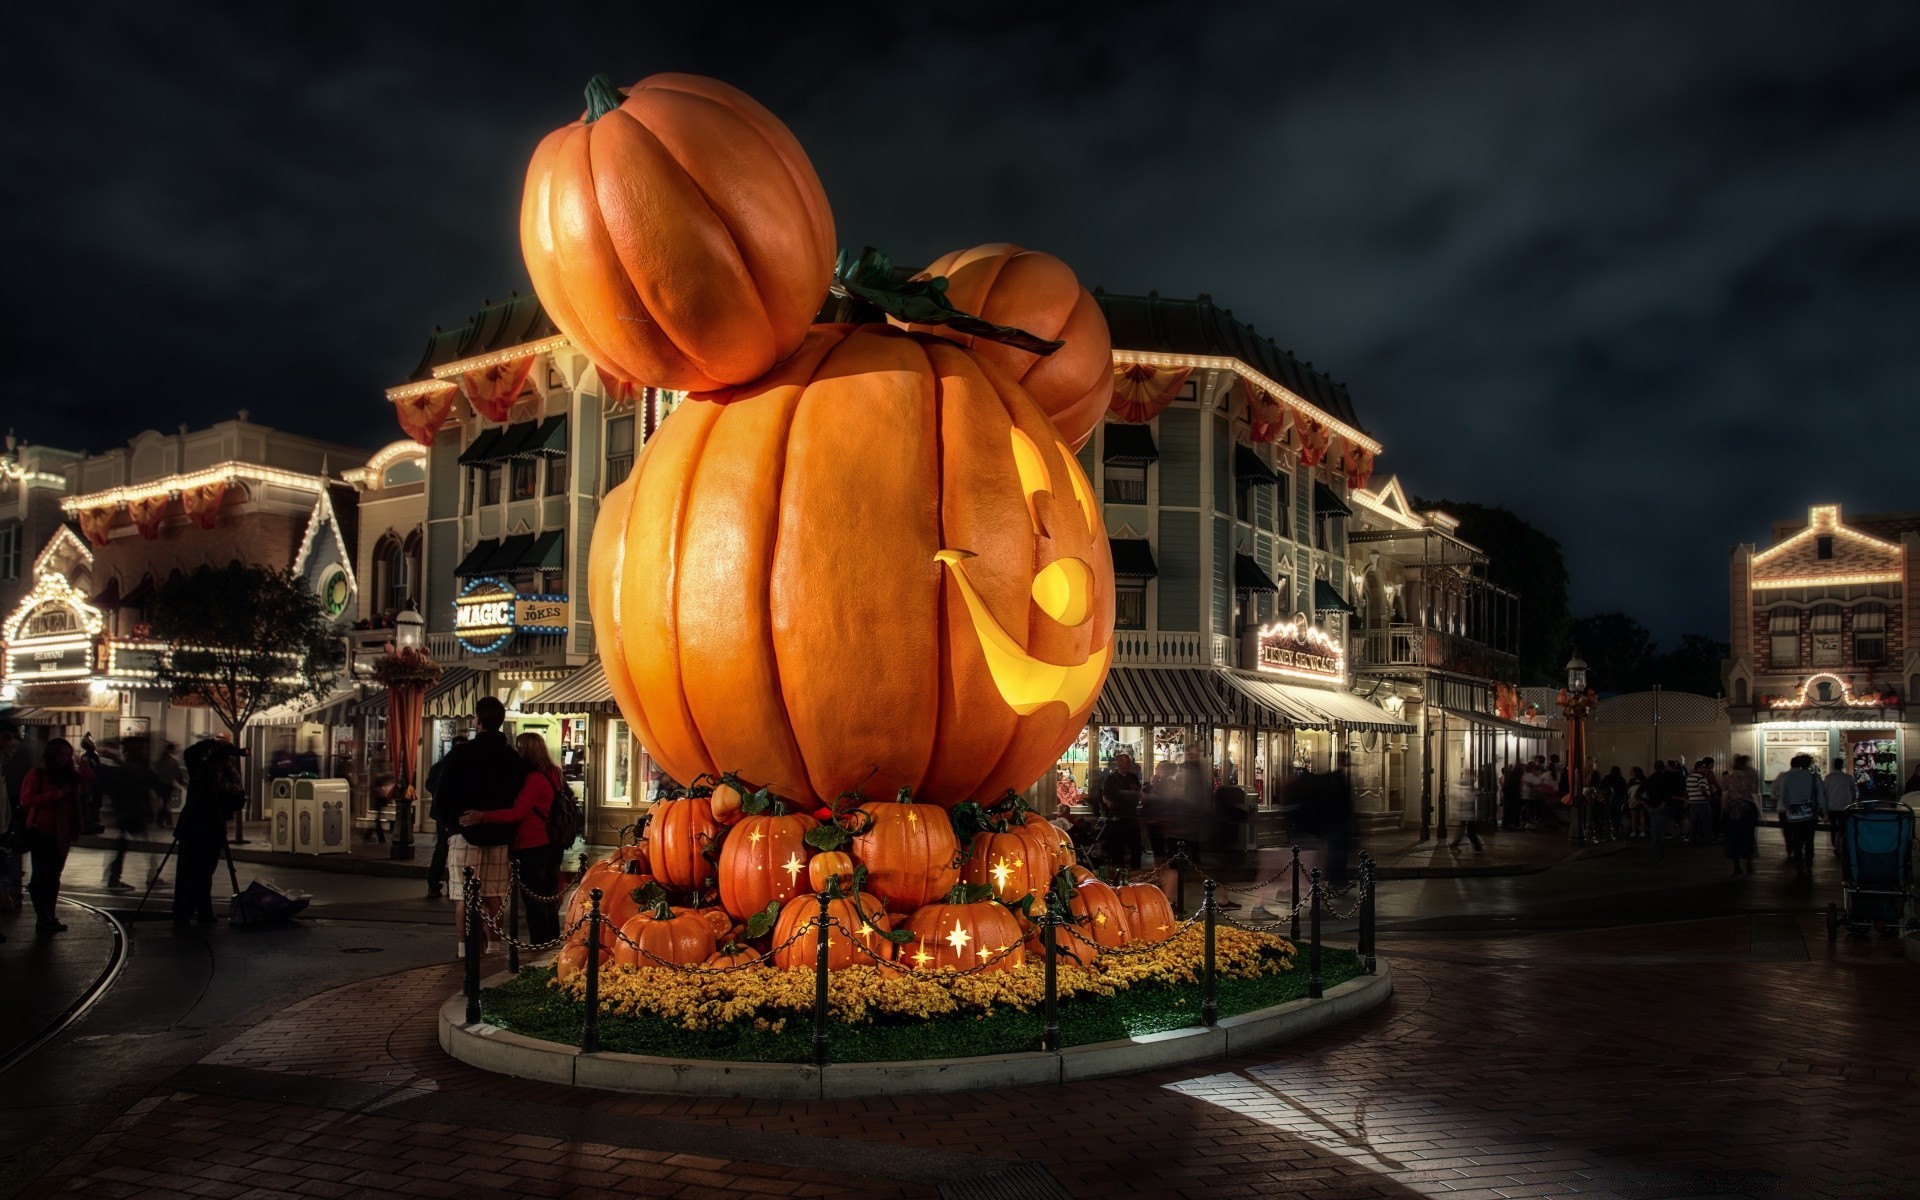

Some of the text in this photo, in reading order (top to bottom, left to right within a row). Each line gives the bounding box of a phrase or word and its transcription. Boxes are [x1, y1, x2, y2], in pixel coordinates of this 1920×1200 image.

[456, 601, 509, 627] MAGIC
[523, 607, 561, 621] JOKES
[1264, 645, 1336, 673] DISNEY SHOWCASE
[1827, 707, 1878, 721] Hatter
